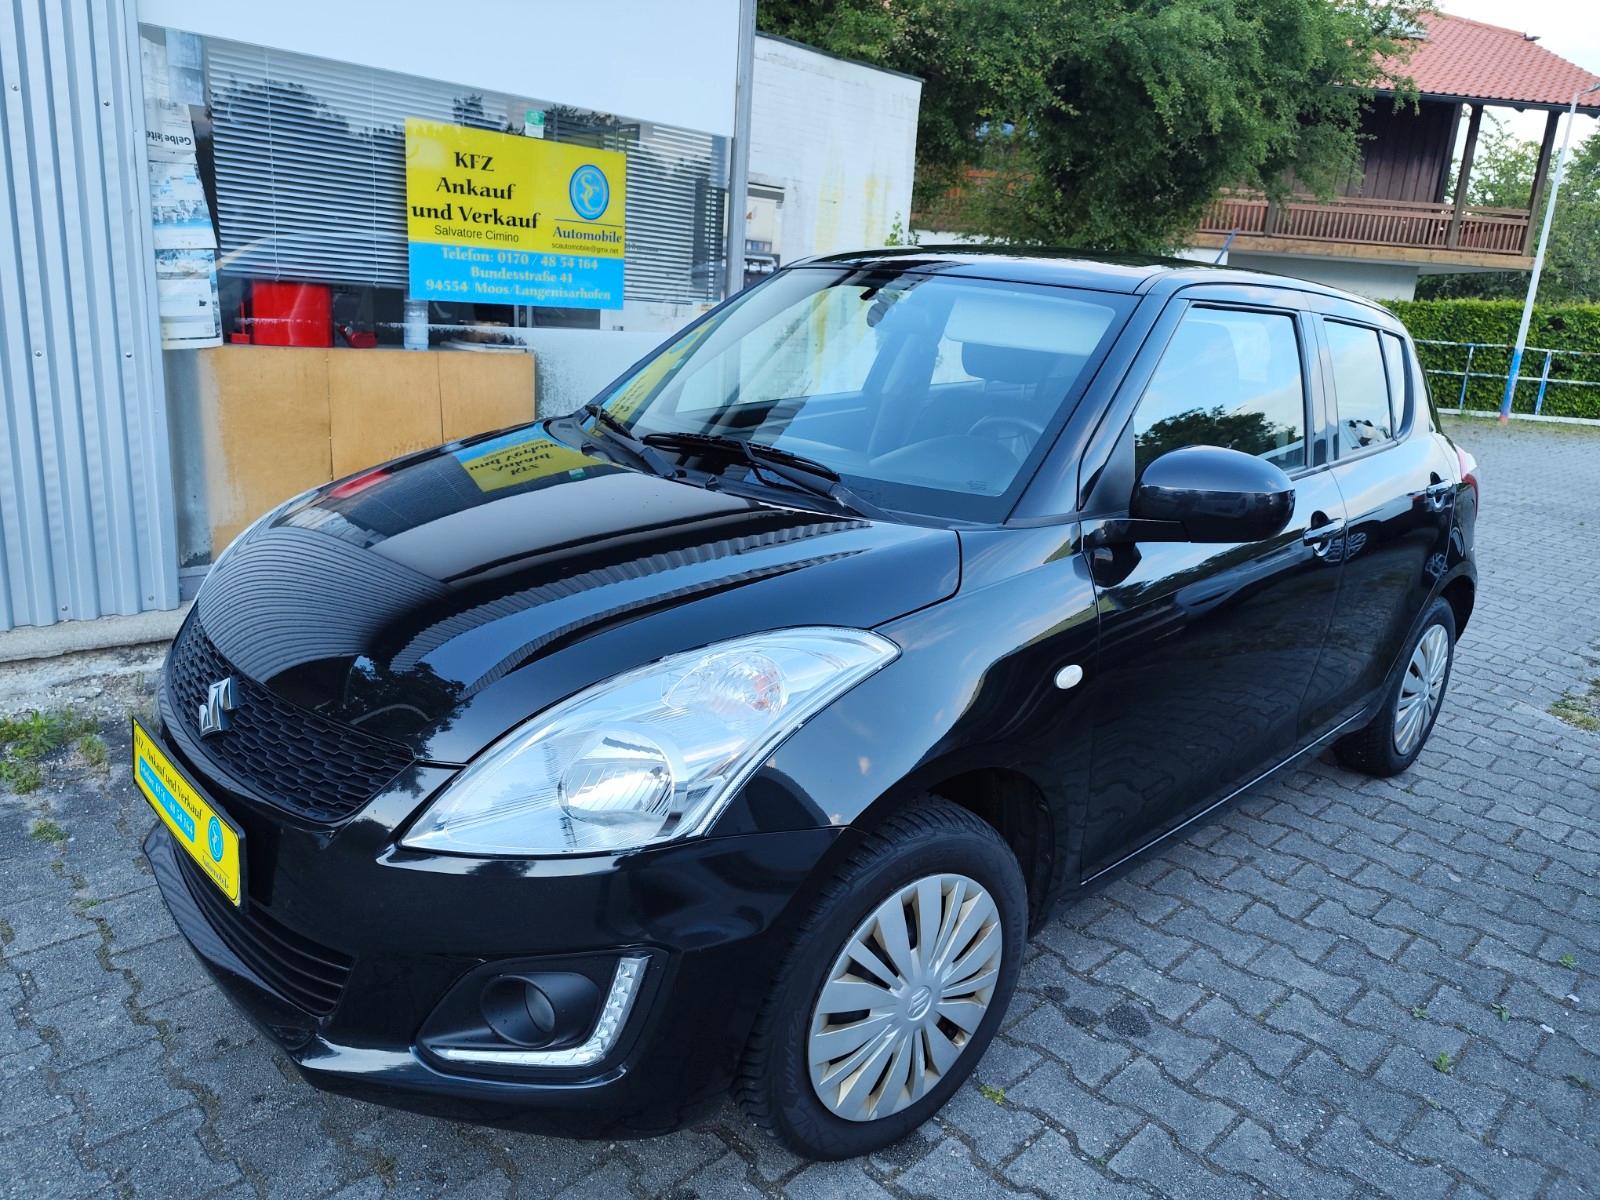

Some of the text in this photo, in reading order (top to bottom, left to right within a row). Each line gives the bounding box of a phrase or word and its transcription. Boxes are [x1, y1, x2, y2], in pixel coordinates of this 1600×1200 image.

[164, 135, 192, 146] Gelbe
[453, 151, 495, 172] KFZ
[436, 176, 517, 200] Ankauf
[411, 203, 542, 229] und Verkauf
[434, 225, 520, 243] Salvatore Cimino
[552, 225, 623, 243] Automobile
[441, 247, 493, 262] Telefon:
[497, 250, 529, 265] 0170
[540, 255, 557, 267] 48
[470, 266, 557, 283] Bundesstraße
[425, 279, 469, 292] 94554
